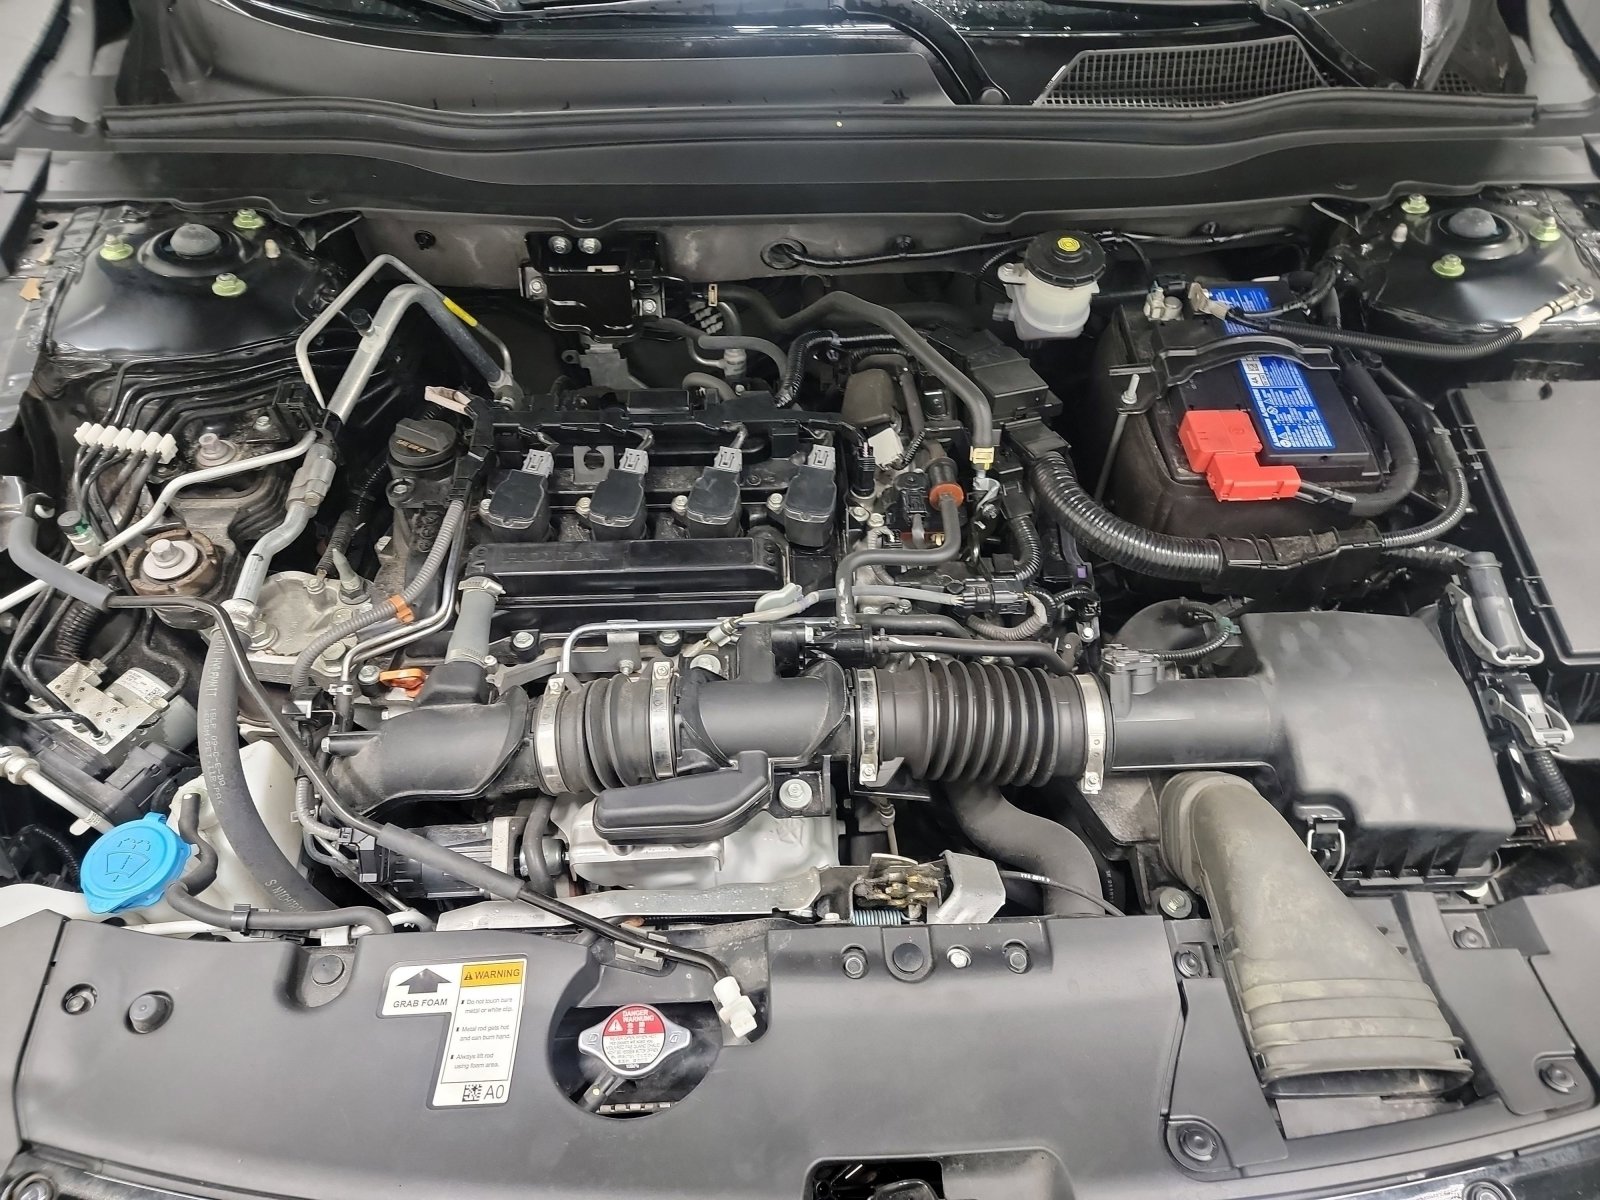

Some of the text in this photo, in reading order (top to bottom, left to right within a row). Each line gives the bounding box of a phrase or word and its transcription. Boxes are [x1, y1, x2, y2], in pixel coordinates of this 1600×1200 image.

[475, 968, 520, 980] WARNING
[393, 998, 448, 1008] GRAB FOAM
